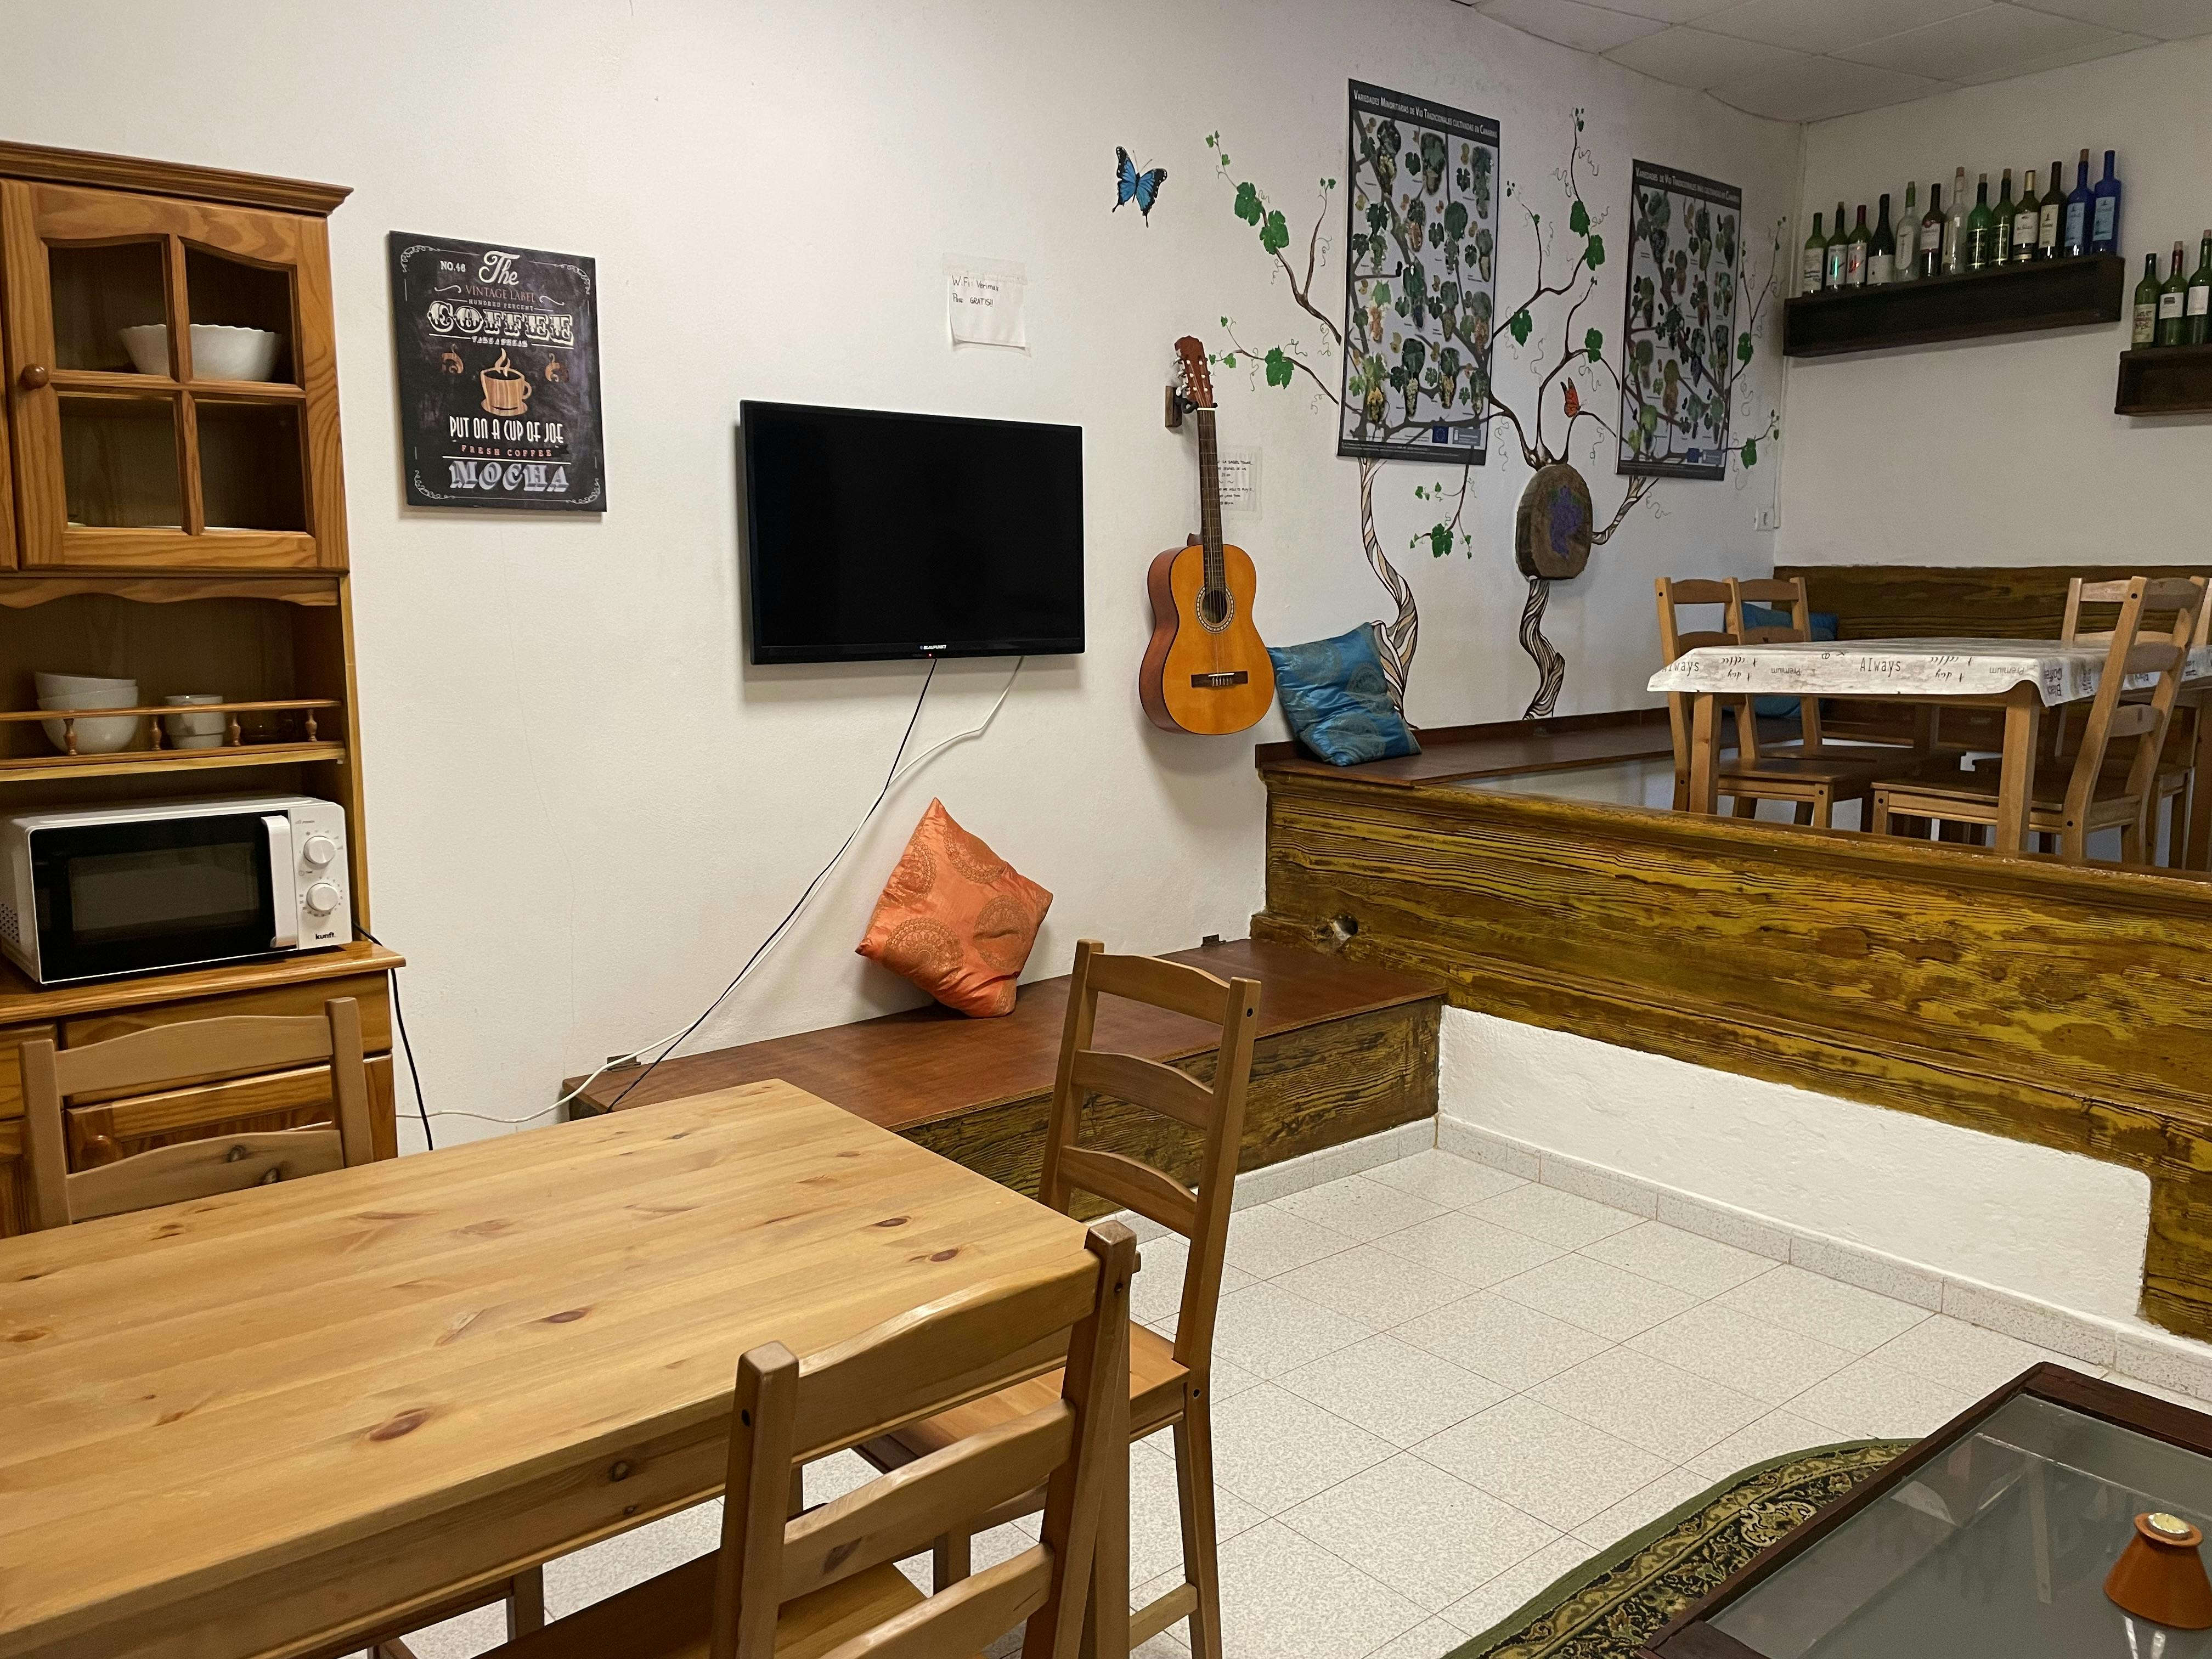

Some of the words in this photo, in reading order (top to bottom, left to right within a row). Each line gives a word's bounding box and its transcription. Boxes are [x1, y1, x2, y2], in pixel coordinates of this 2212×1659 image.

[478, 250, 520, 285] The
[465, 284, 507, 299] VINTAGE
[510, 290, 536, 303] LABEL
[503, 303, 534, 311] PERCENT
[427, 300, 574, 347] COFFEE
[449, 415, 470, 438] PUT
[473, 417, 488, 439] ON
[491, 419, 501, 440] A
[504, 420, 524, 441] CUP
[526, 421, 541, 442] OF
[544, 422, 564, 444] JOE
[461, 444, 501, 456] FRESH
[506, 449, 552, 457] COFFEE
[448, 460, 569, 493] MOCHA
[1771, 667, 1801, 676] Premium
[1989, 665, 2025, 676] Premium
[315, 932, 335, 940] kunft
